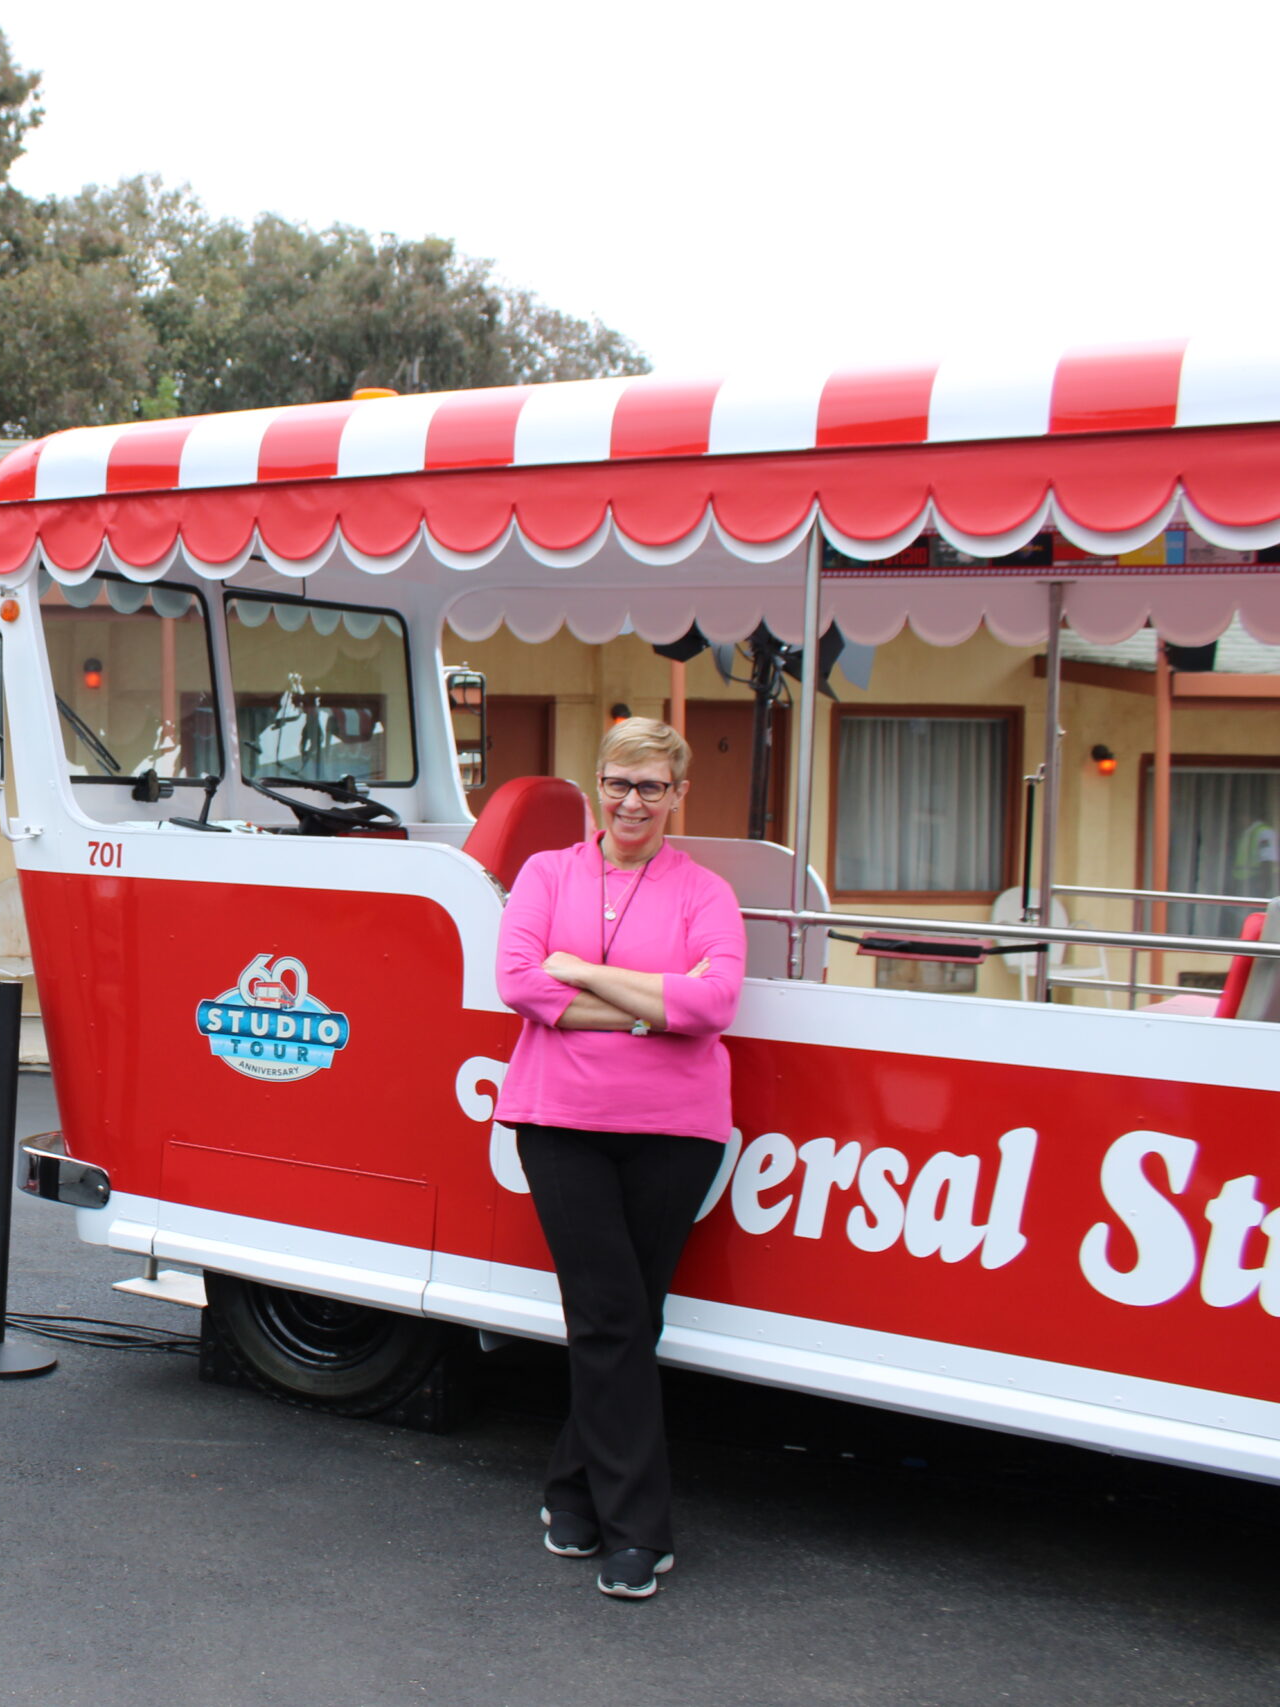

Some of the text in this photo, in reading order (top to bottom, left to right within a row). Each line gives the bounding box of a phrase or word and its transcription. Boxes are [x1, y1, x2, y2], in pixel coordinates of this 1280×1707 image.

[718, 736, 729, 754] 6
[88, 841, 123, 868] 701
[237, 953, 309, 1012] 60
[206, 1008, 341, 1044] STUDIO
[230, 1038, 309, 1063] TOUR
[238, 1060, 300, 1077] ANNIVERSARY
[455, 1056, 1280, 1318] ersal St
